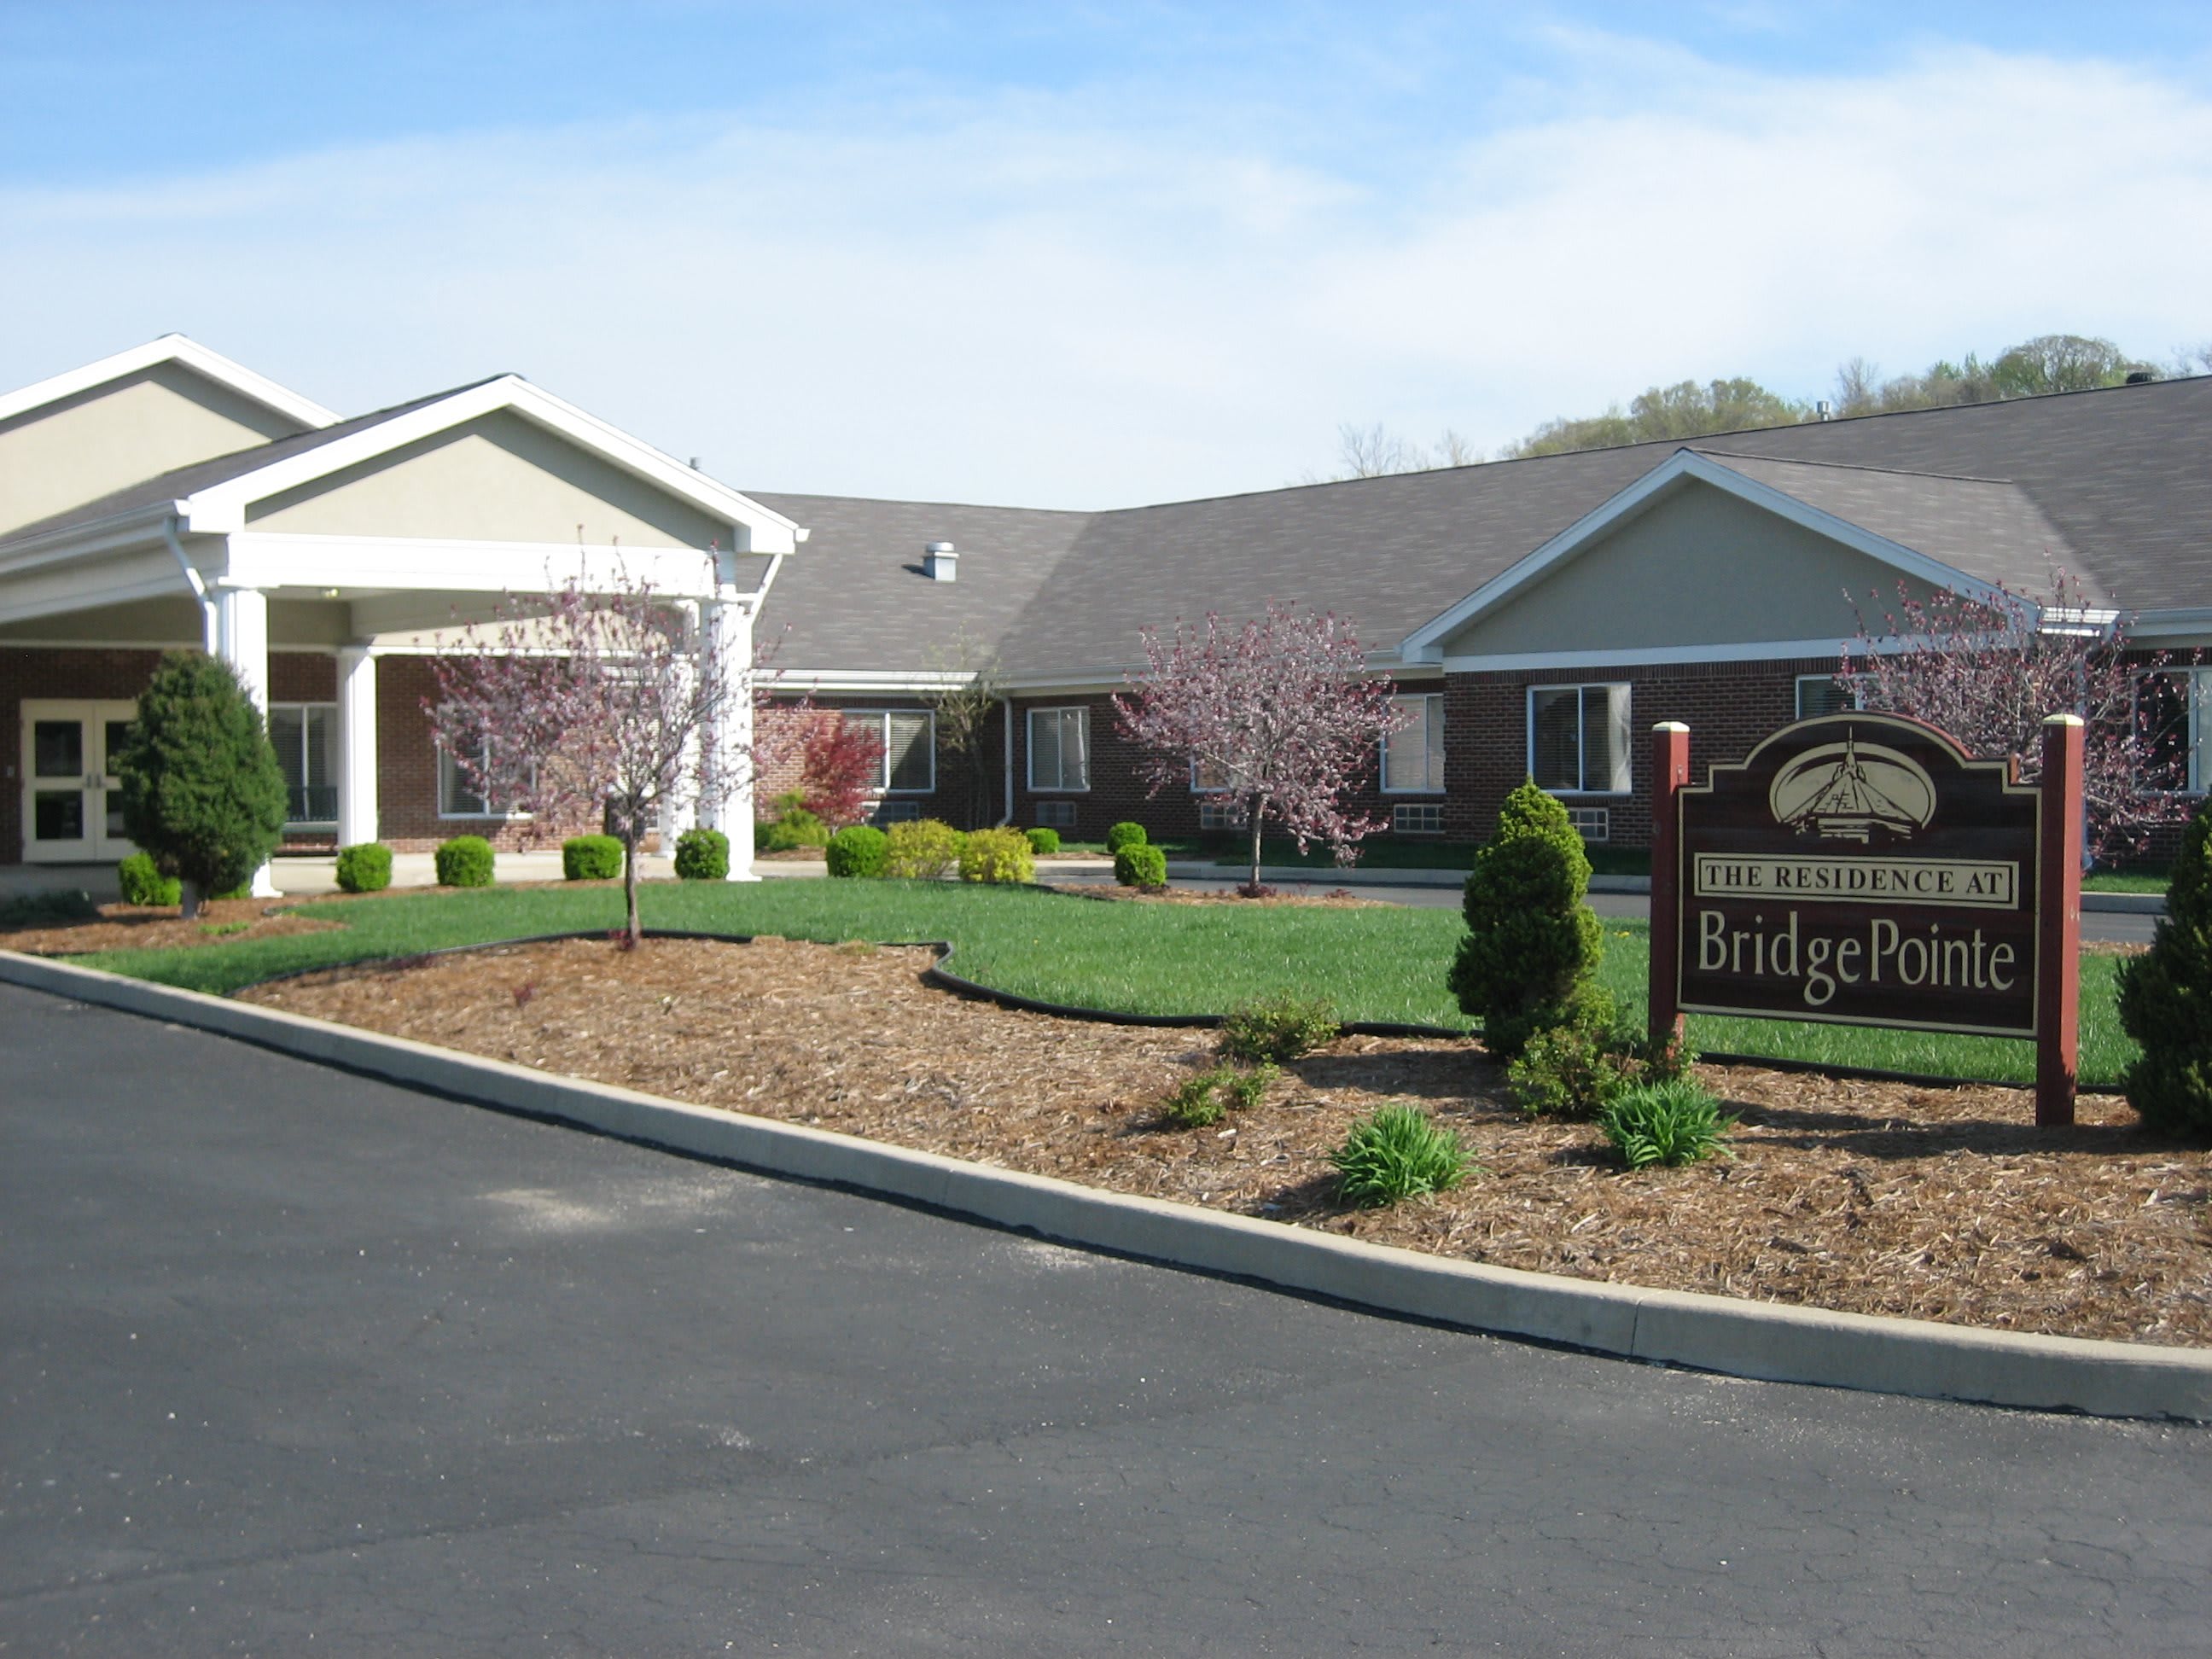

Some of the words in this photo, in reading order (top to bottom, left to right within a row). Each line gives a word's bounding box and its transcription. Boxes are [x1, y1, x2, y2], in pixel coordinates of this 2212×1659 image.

[1706, 864, 1762, 887] THE
[1775, 869, 1954, 894] RESIDENCE
[1966, 872, 2003, 895] AT
